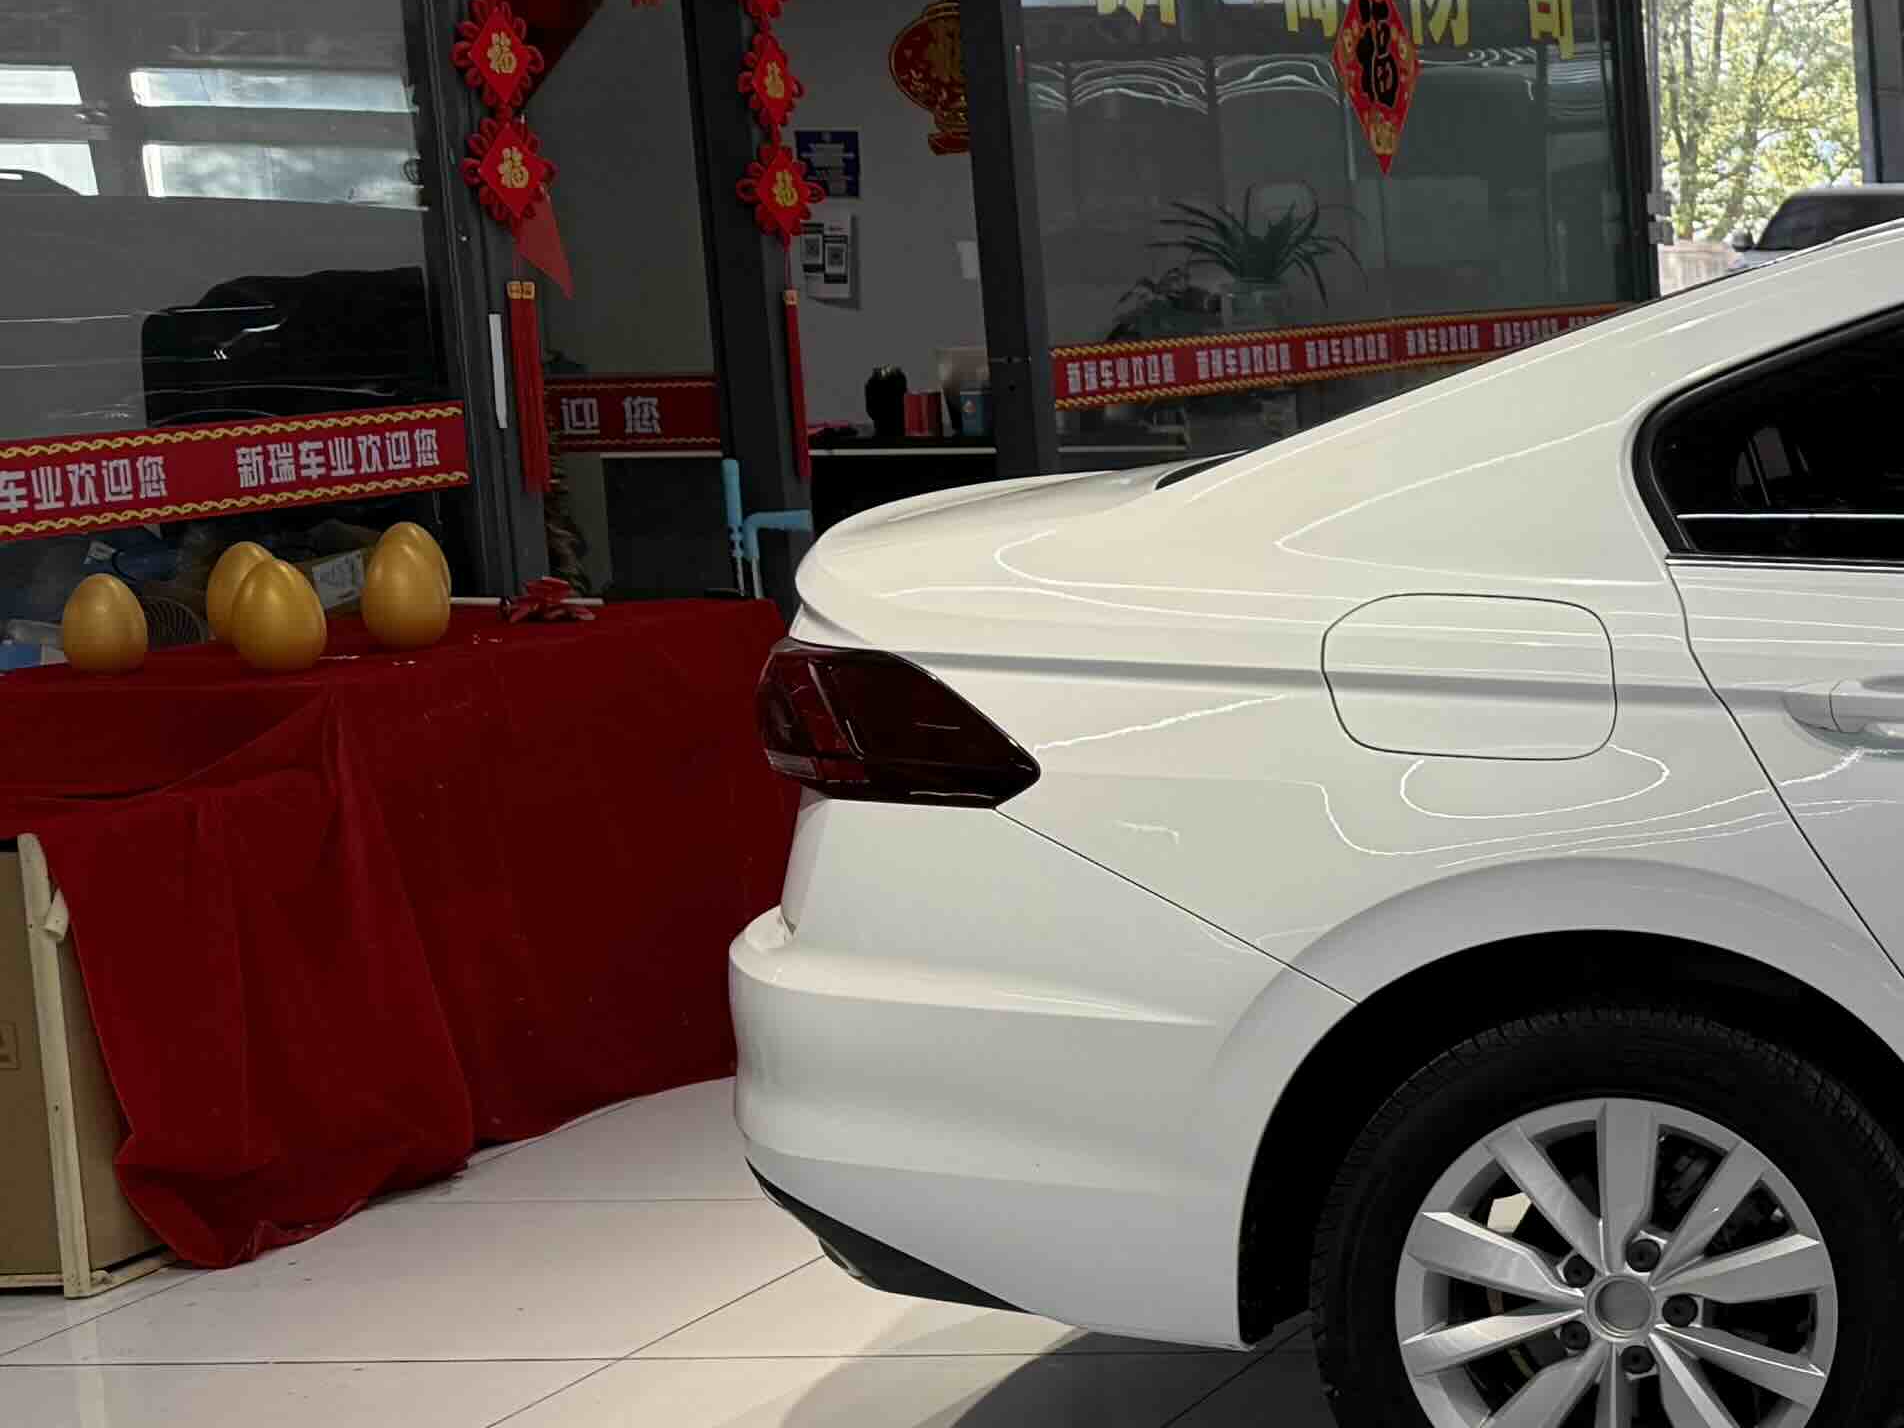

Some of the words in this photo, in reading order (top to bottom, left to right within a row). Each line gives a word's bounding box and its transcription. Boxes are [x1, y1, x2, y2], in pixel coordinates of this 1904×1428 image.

[235, 428, 441, 489] 新瑞车业欢迎您
